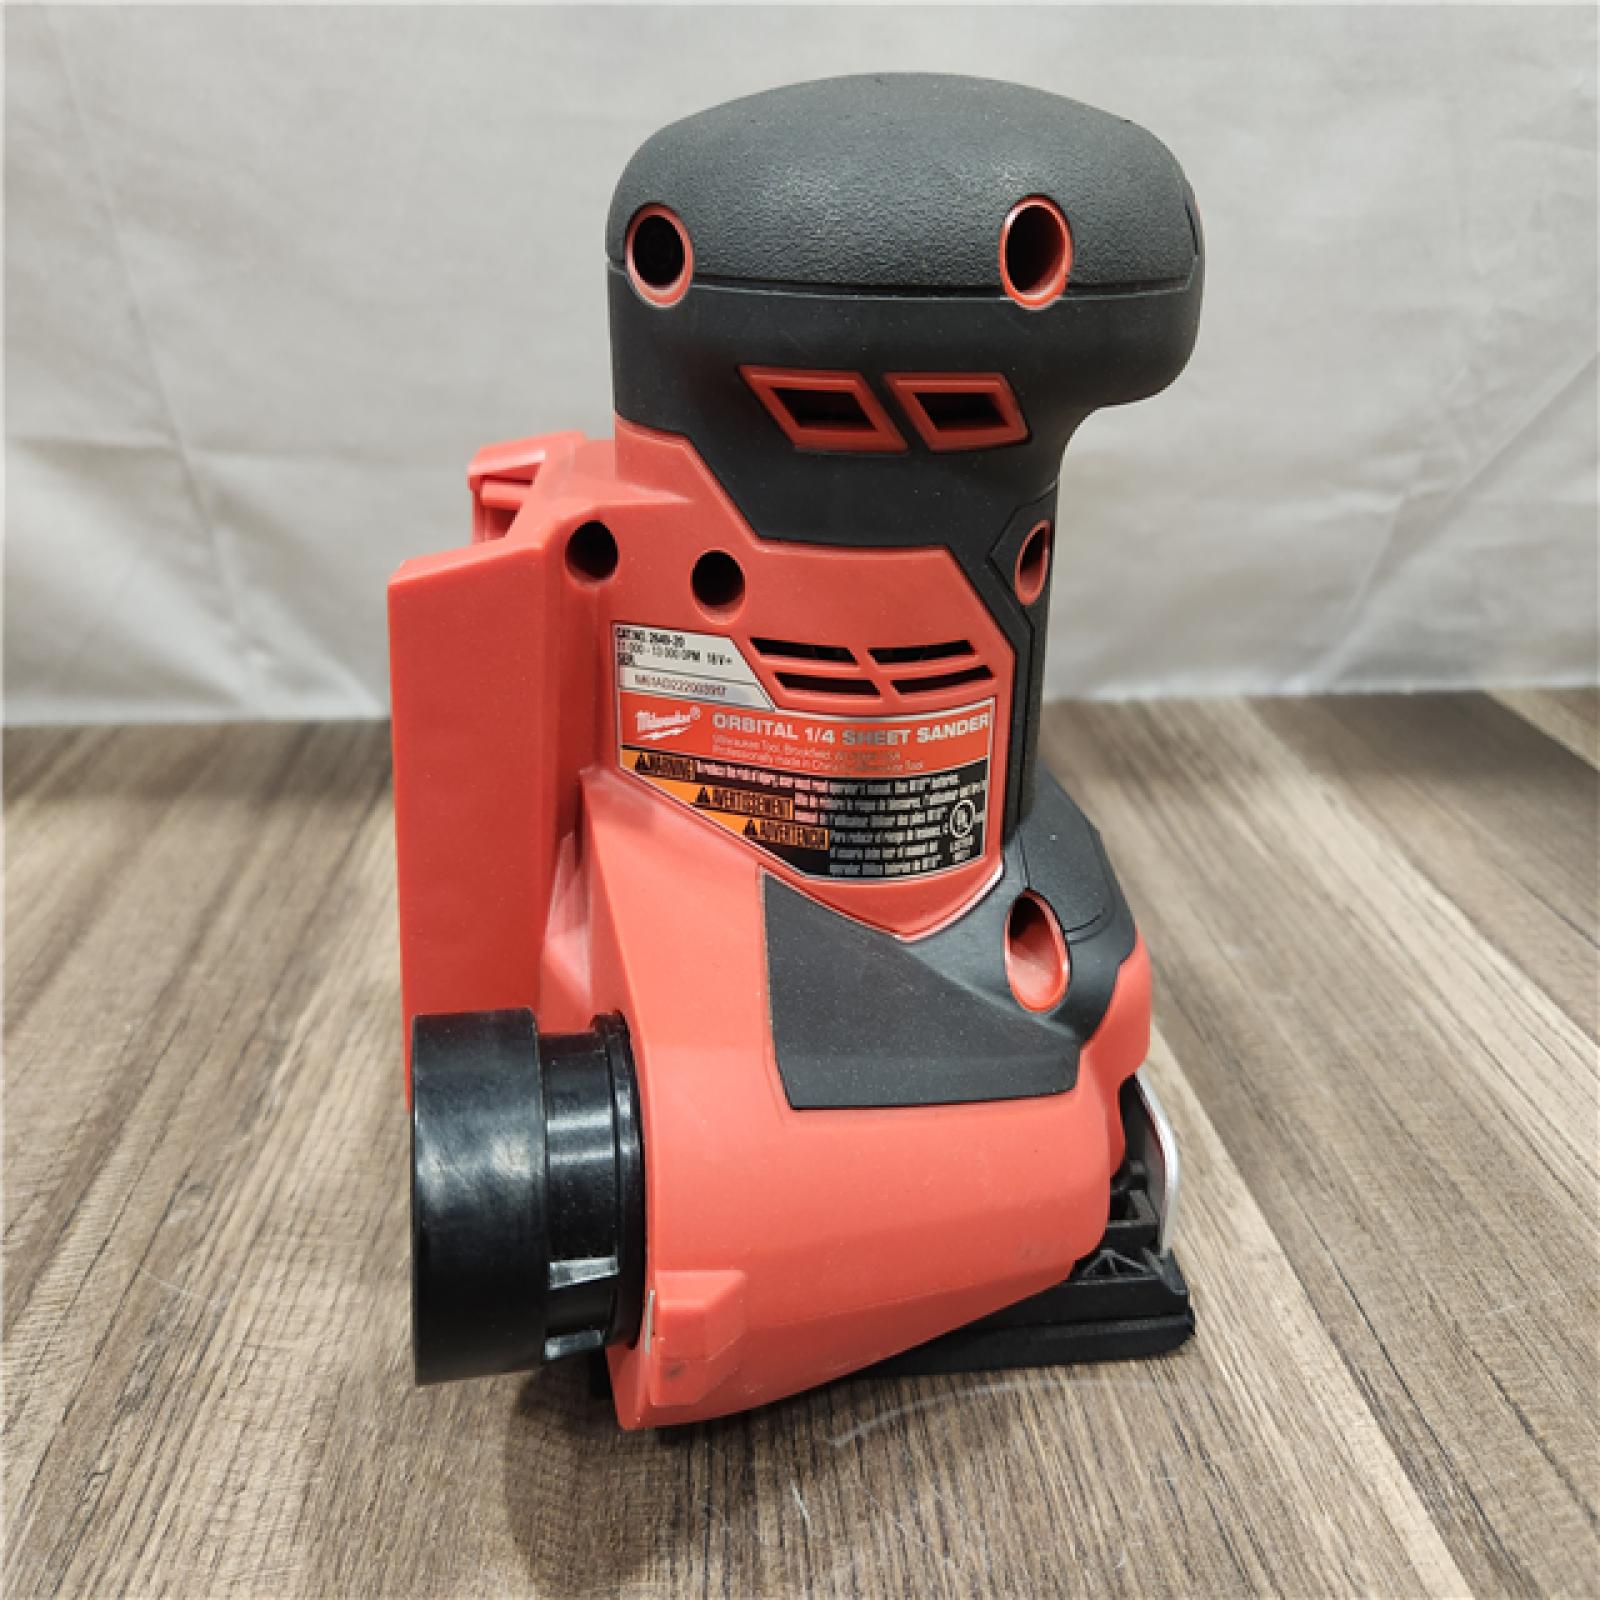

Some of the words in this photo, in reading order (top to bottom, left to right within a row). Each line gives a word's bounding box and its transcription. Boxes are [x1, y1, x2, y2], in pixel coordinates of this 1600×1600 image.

[711, 711, 799, 741] ORBITAL
[803, 726, 836, 745] 1/4
[841, 728, 912, 746] SHEET
[916, 711, 990, 744] SANDER
